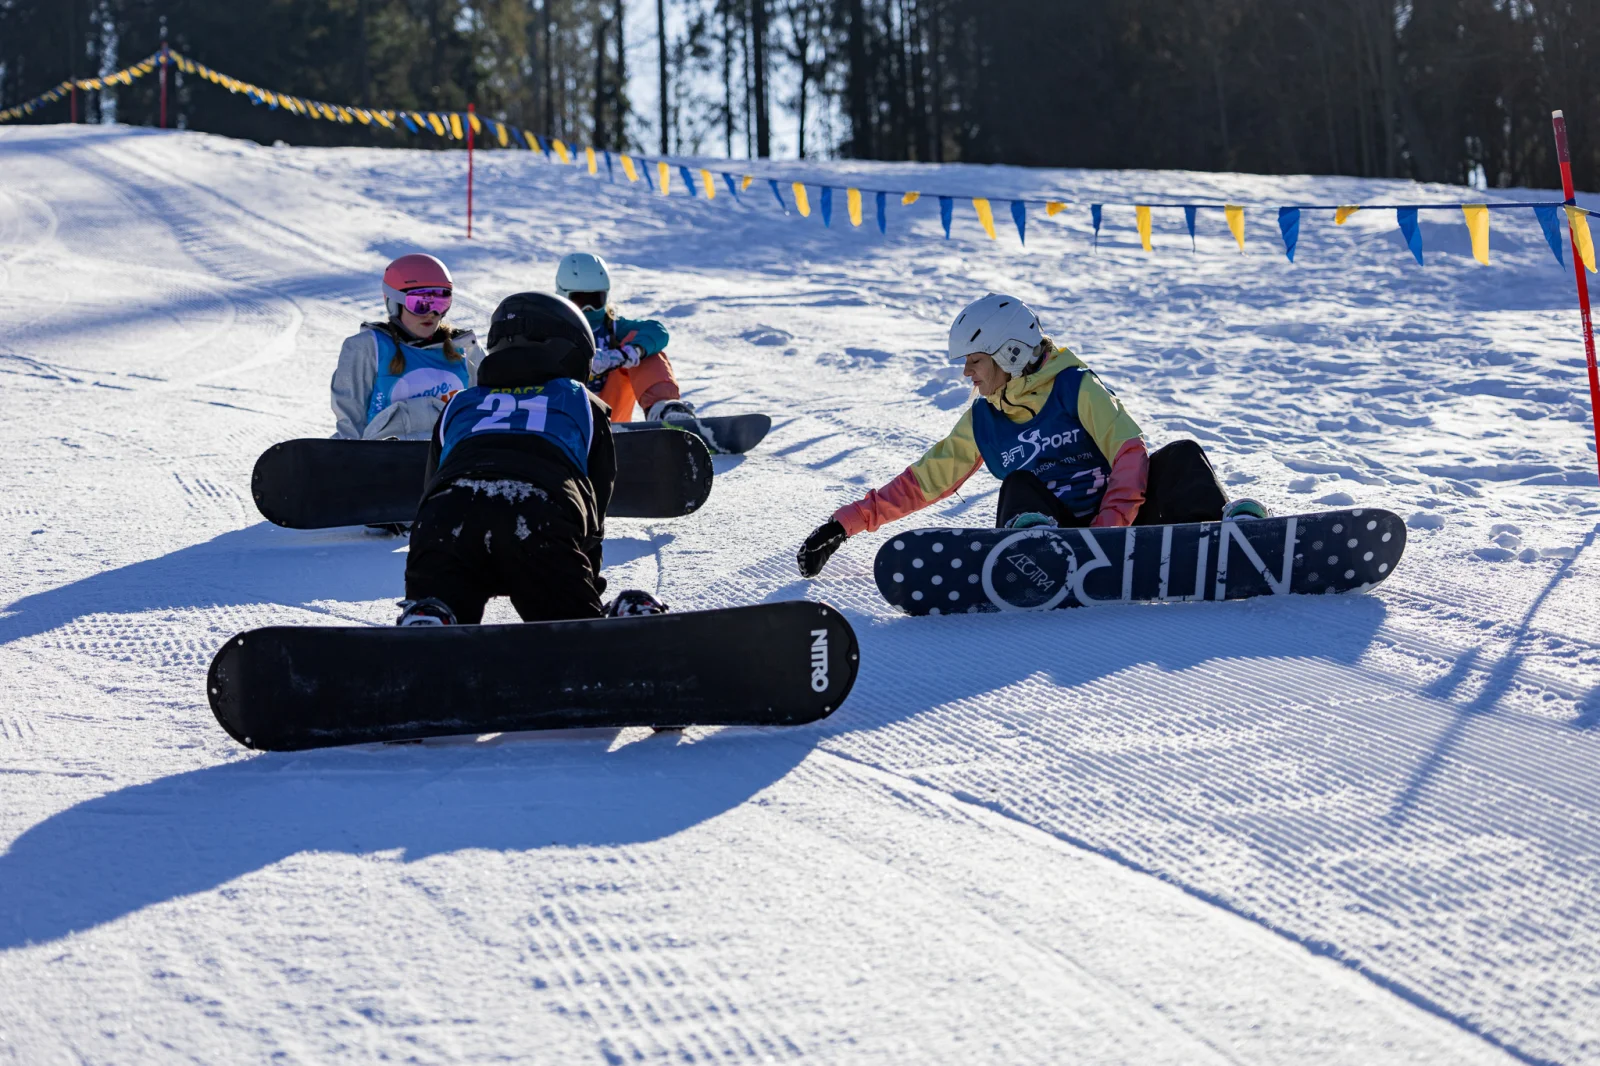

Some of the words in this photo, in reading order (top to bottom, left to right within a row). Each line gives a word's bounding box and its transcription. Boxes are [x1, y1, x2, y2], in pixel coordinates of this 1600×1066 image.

[472, 393, 548, 432] 21
[981, 517, 1298, 611] NITRO
[811, 629, 829, 692] NITRO
